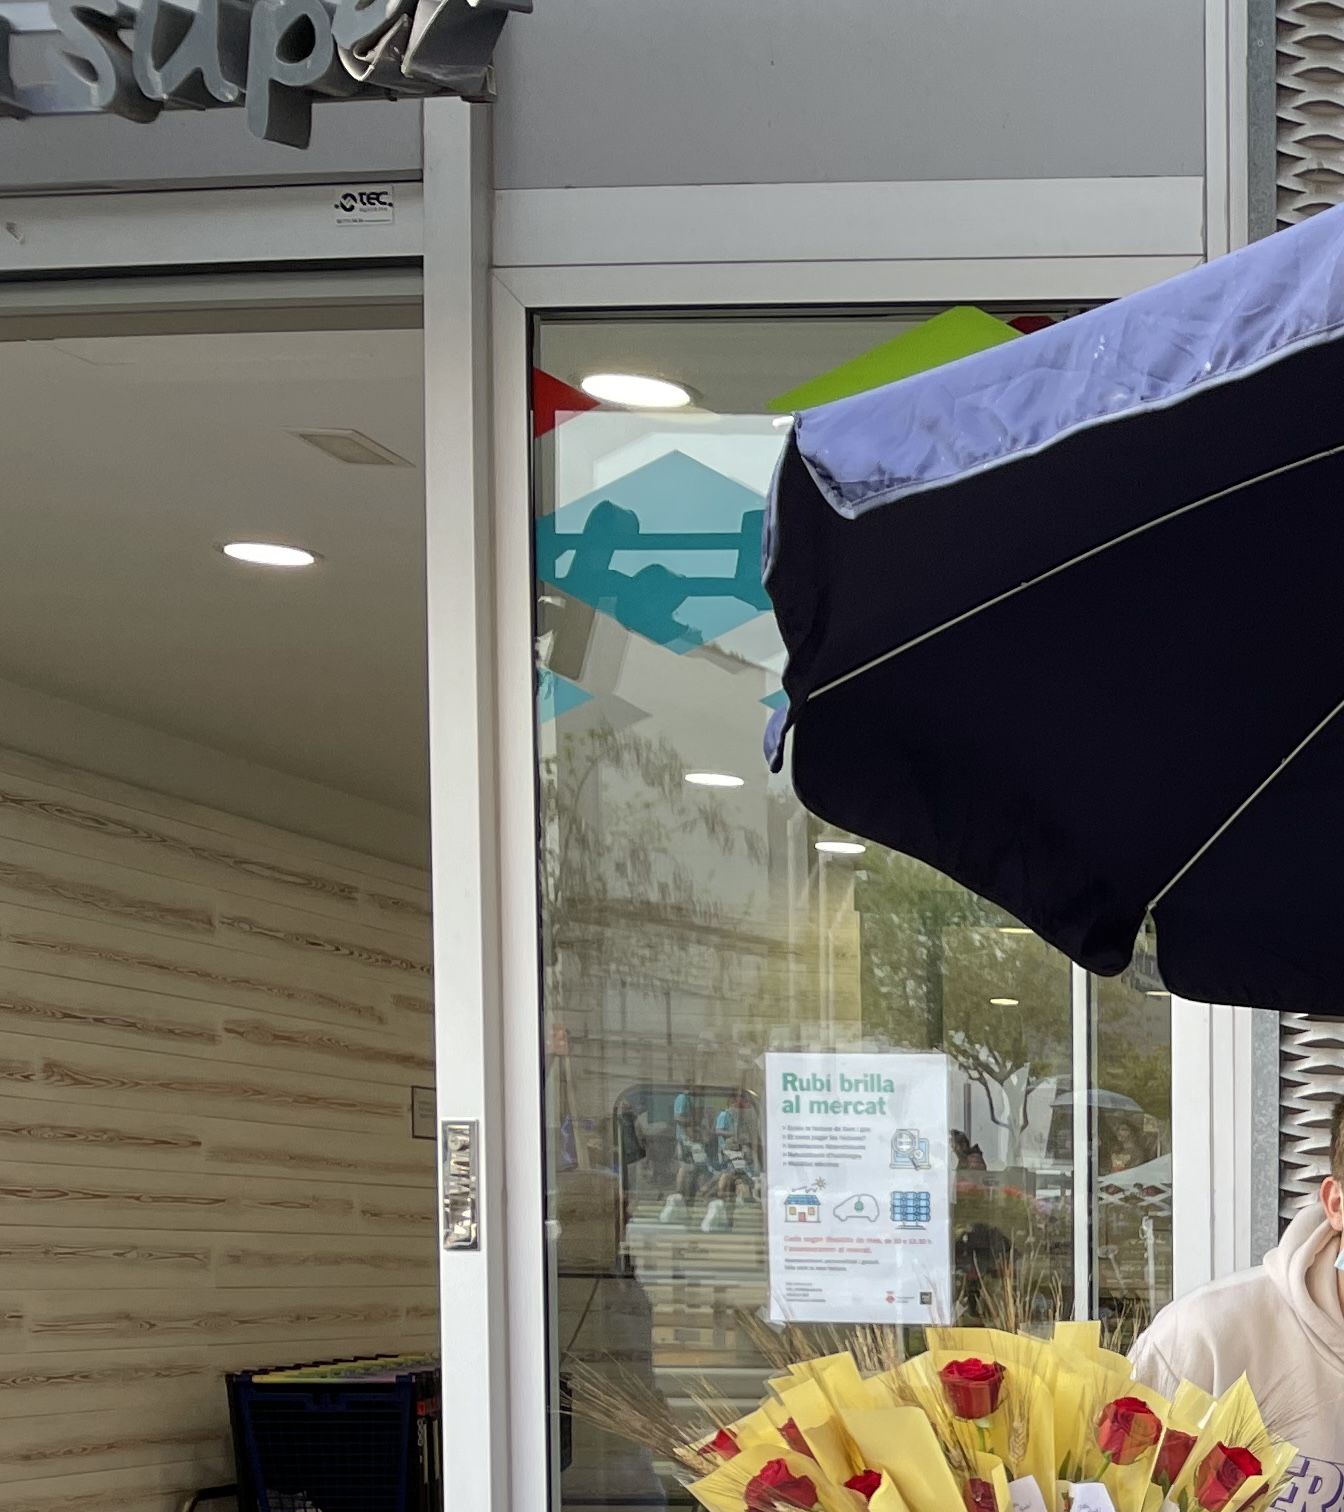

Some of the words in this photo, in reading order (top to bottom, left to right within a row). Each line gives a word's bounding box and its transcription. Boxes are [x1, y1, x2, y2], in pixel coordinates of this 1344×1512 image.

[840, 1073, 894, 1092] brilla
[782, 1095, 800, 1114] al
[809, 1098, 886, 1115] mercat
